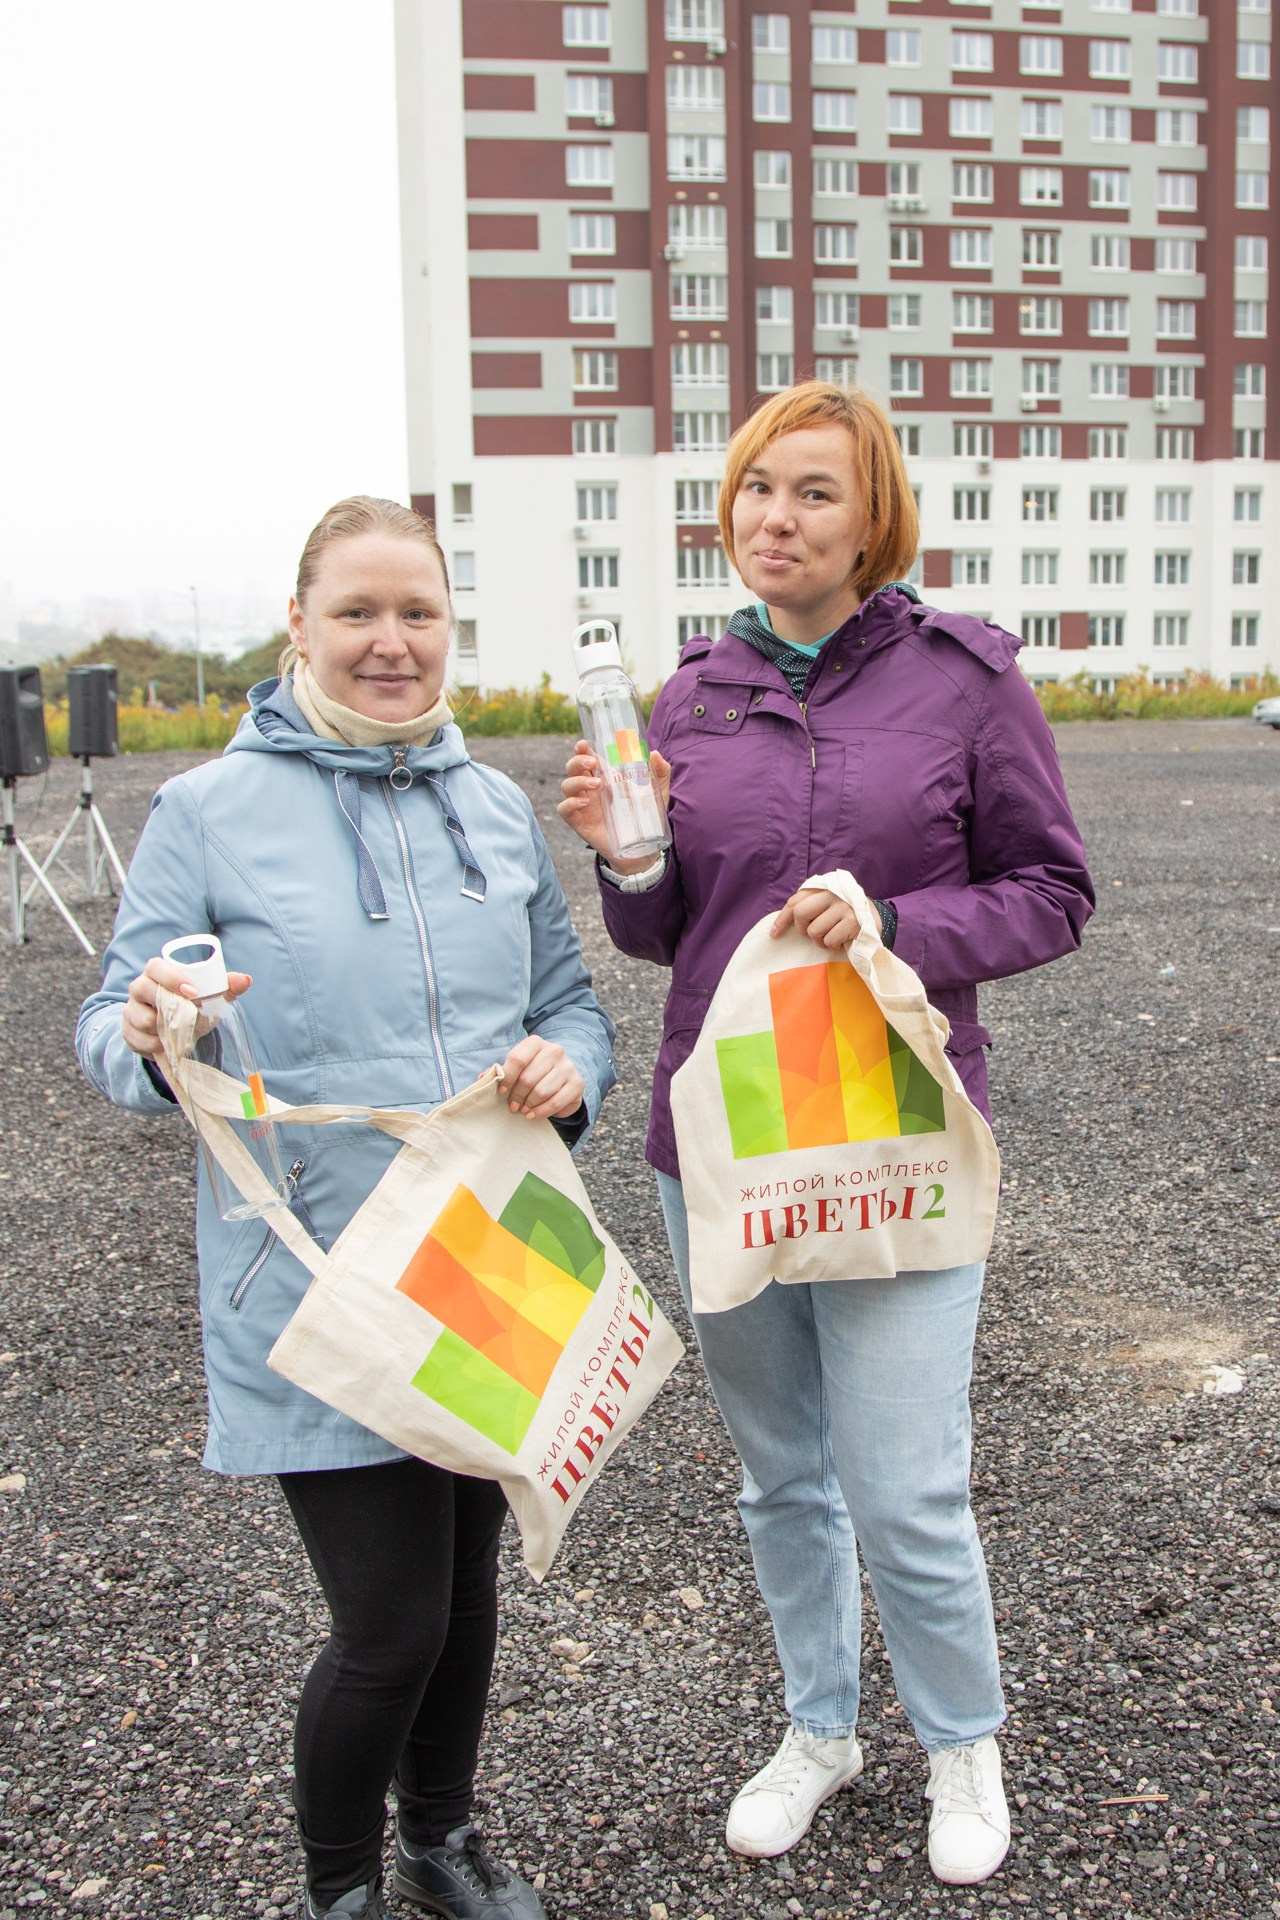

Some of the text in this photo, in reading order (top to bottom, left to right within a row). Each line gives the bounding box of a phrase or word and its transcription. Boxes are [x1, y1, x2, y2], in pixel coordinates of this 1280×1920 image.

[740, 1160, 949, 1202] ЖИЛОЙ КОМПЛЕКС
[537, 1267, 628, 1481] ЖИЛОЙ КОМПЛЕКС
